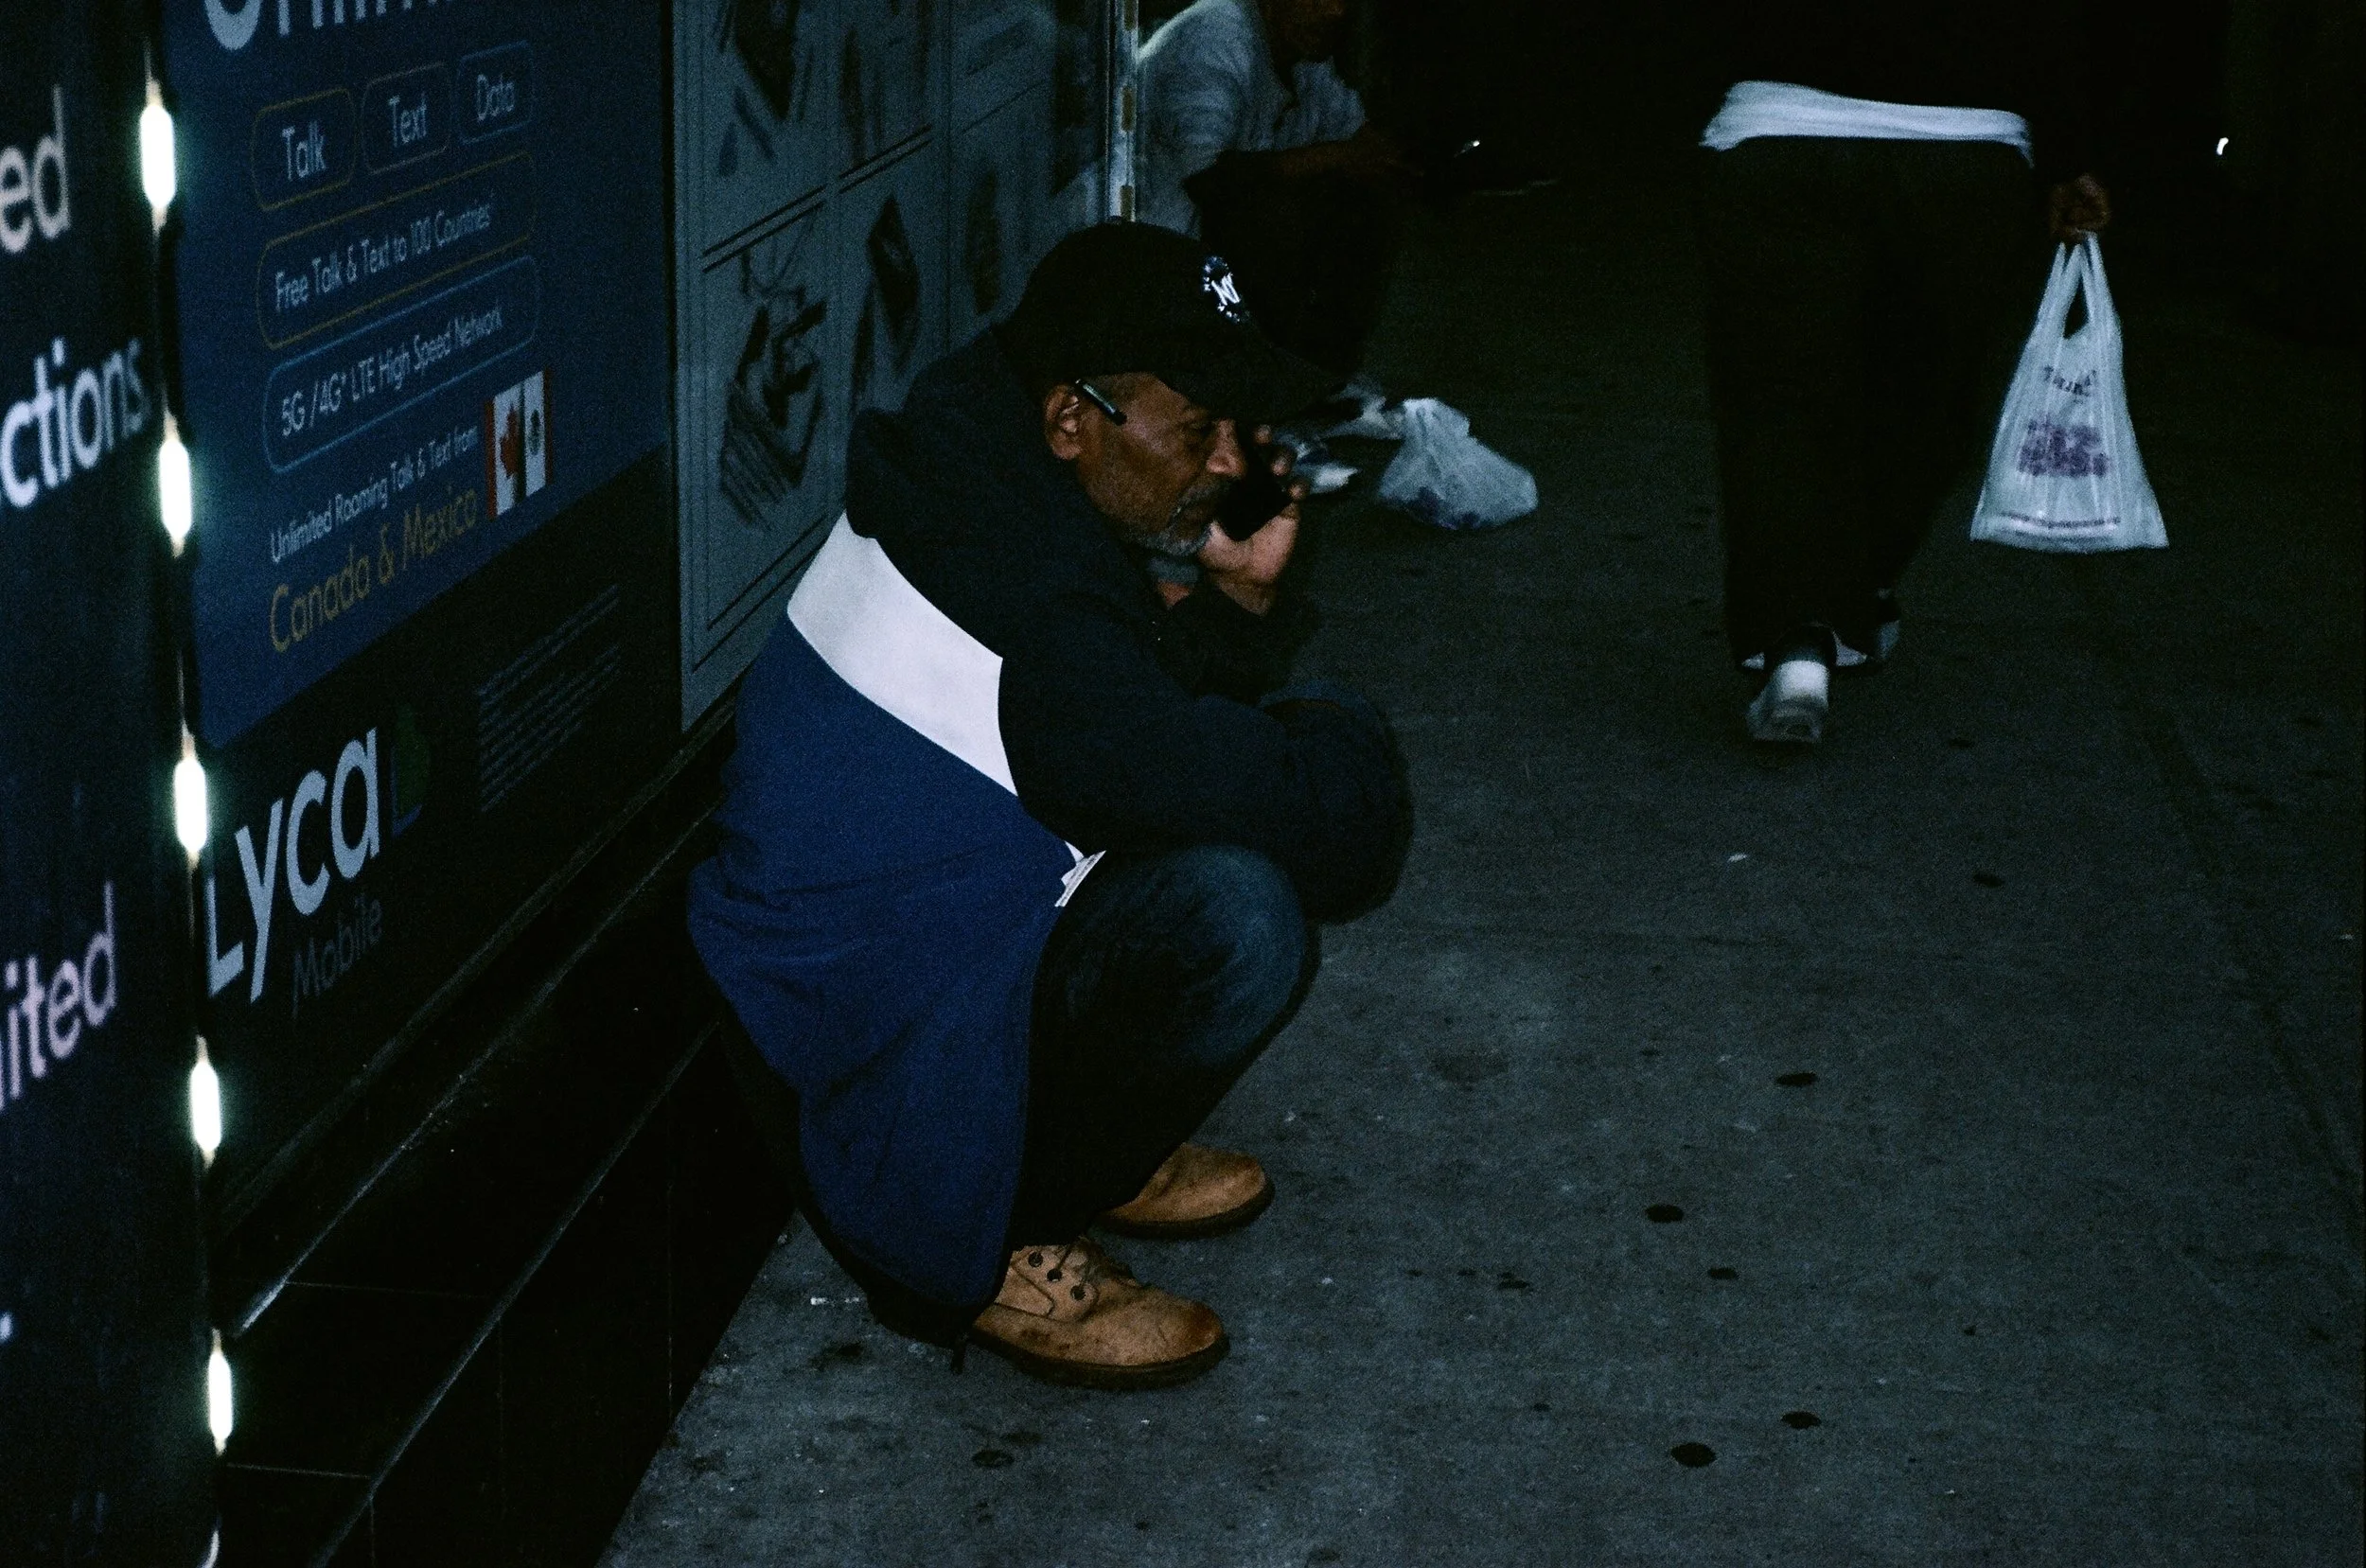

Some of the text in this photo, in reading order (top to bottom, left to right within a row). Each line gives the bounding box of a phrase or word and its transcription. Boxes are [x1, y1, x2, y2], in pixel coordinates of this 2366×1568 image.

[282, 119, 327, 182] Talk
[387, 95, 429, 149] Text
[475, 73, 516, 122] Data
[274, 270, 309, 313] Free
[311, 255, 343, 295] Talk
[361, 236, 391, 275] Text
[393, 233, 407, 263] to
[281, 390, 307, 438] 5G
[351, 355, 376, 403] LTE
[380, 343, 412, 391] High
[414, 322, 450, 378] Speed
[454, 303, 504, 350] Network
[270, 498, 332, 564] Unlimited
[335, 474, 389, 528] Roaming
[390, 453, 415, 492] Talk
[428, 432, 451, 470] Text
[269, 543, 371, 653] Canada
[402, 482, 478, 572] Mexico
[204, 726, 382, 1005] Lyca
[0, 880, 116, 1112] ited
[291, 892, 383, 1020] Mobile
